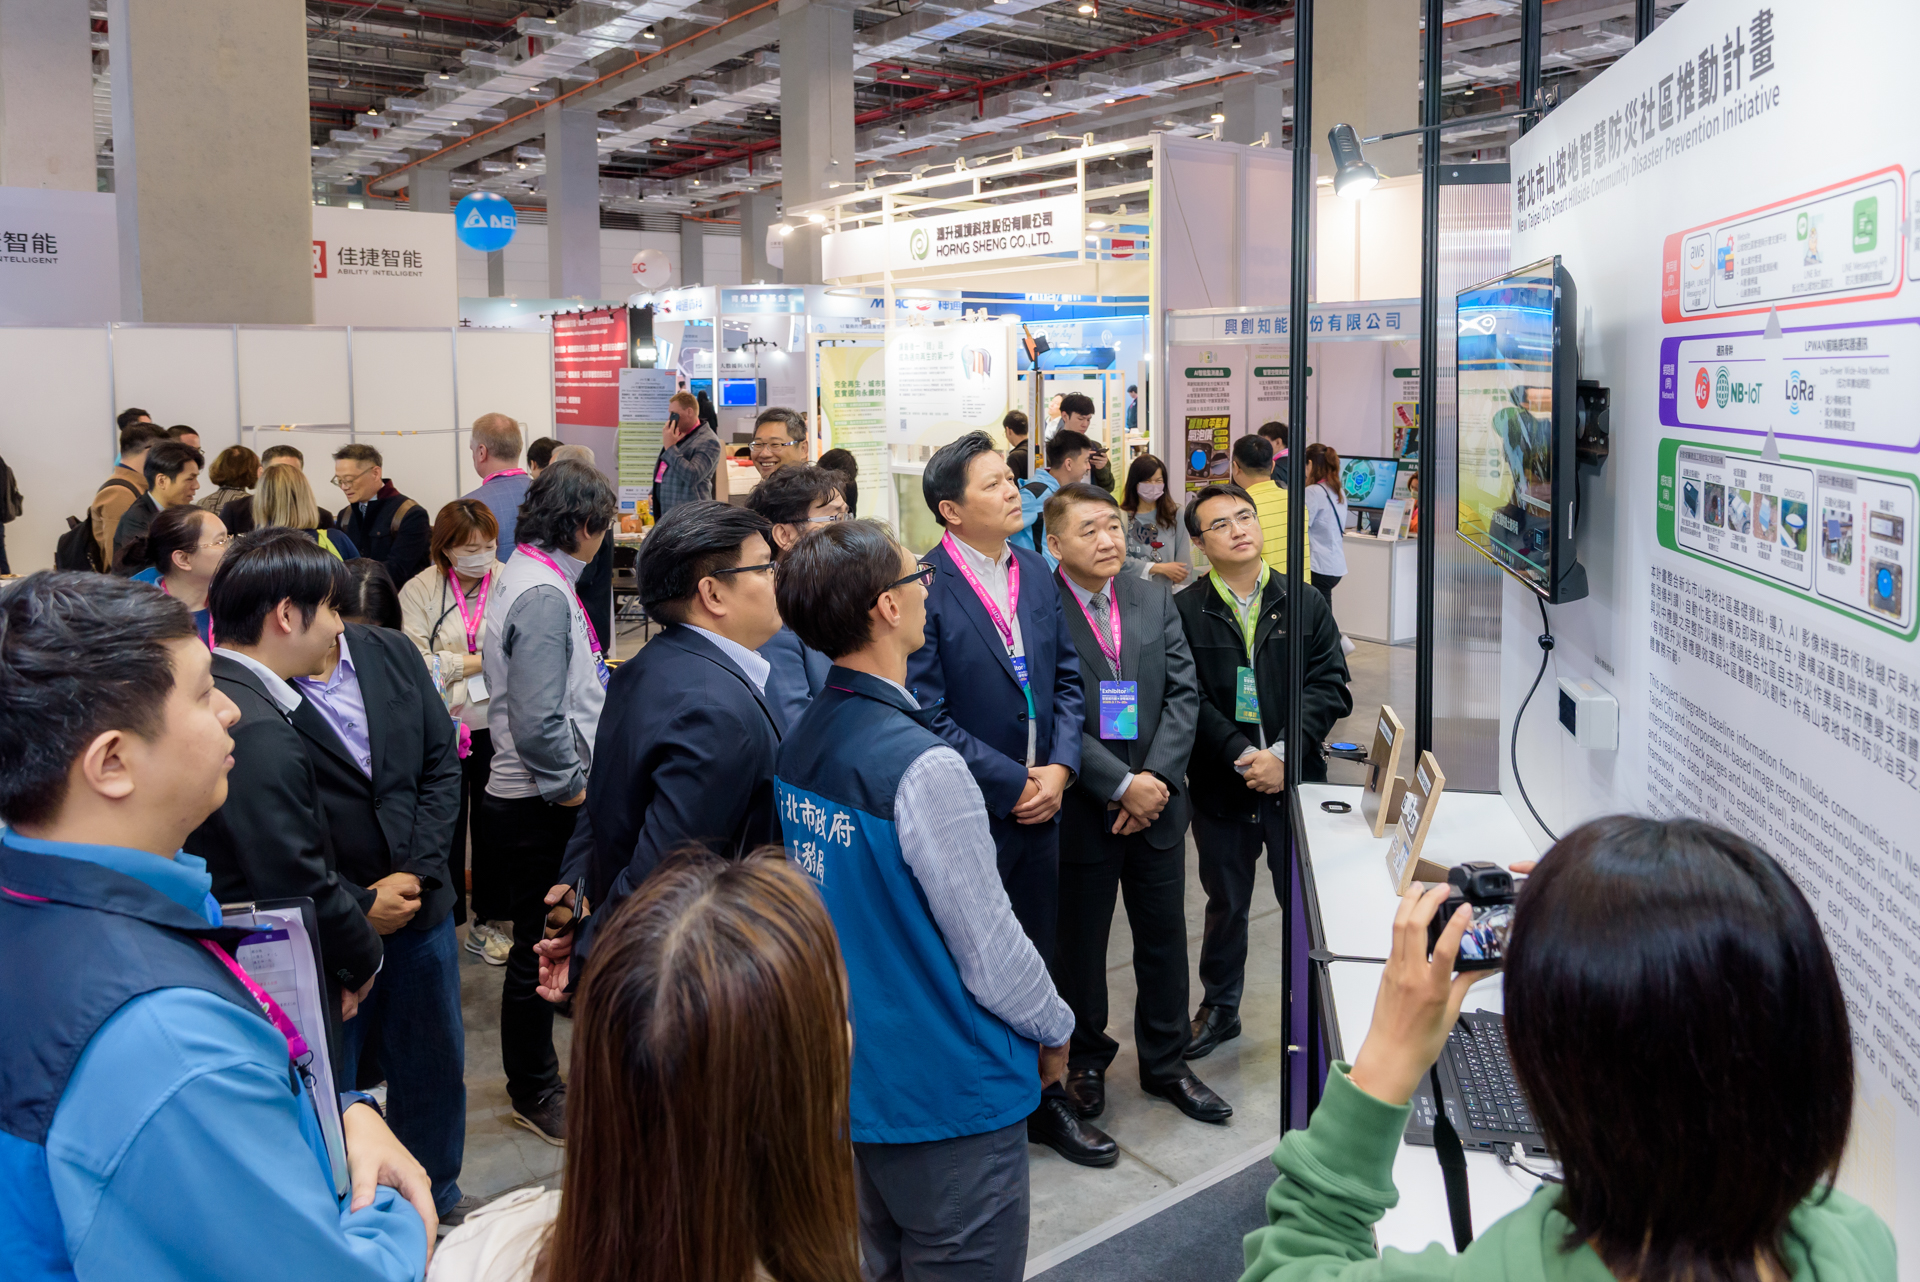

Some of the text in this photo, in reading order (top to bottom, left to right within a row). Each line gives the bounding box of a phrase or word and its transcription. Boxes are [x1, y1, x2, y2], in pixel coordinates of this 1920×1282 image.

[1518, 8, 1774, 213] 新北市山坡地智慧防災社區推動計畫
[1518, 85, 1780, 234] New Taipei City Smart Hillside Community Disaster Prevention Initiative
[0, 231, 58, 254] 智能
[936, 232, 1053, 256] HORNG SHENG CO.,LTD.
[1690, 244, 1705, 259] aws
[338, 246, 422, 268] 佳捷智能
[373, 269, 423, 277] INTELLIGENT
[1225, 312, 1401, 335] 興創知能份有限公司
[1696, 384, 1706, 400] 4G
[1730, 382, 1762, 404] NB-IoT
[1785, 379, 1814, 401] LoRa
[1789, 624, 1798, 641] AI
[1648, 760, 1673, 793] in-disaster
[1649, 672, 1920, 880] This project integrates baseline information from hillside communities in Ne
[1647, 781, 1658, 798] with
[1649, 690, 1920, 910] Taipei City and incorporates AI-based image recognition technologies (includin
[1649, 707, 1682, 744] interpretation
[1684, 736, 1690, 749] of
[1690, 742, 1705, 761] crack
[1706, 753, 1727, 778] gauges
[1728, 770, 1740, 788] and
[1742, 776, 1766, 808] bubble
[1767, 795, 1788, 830] level),
[1790, 818, 1834, 862] automated
[1836, 854, 1884, 912] monitoring
[1648, 729, 1658, 743] and
[1663, 742, 1686, 766] real-time
[1687, 757, 1700, 777] data
[1701, 769, 1727, 799] platform
[1728, 789, 1735, 805] to
[1737, 799, 1767, 831] establish
[1775, 829, 1833, 888] comprehensive
[1836, 878, 1869, 920] disaster
[1648, 742, 1674, 776] framework
[1679, 772, 1702, 803] covering
[1707, 793, 1718, 812] risk
[1775, 852, 1820, 901] pre-disaster
[1828, 900, 1848, 931] early
[1856, 924, 1896, 977] warning,
[1823, 921, 1882, 988] preparedness
[1879, 1053, 1920, 1117] in urban
